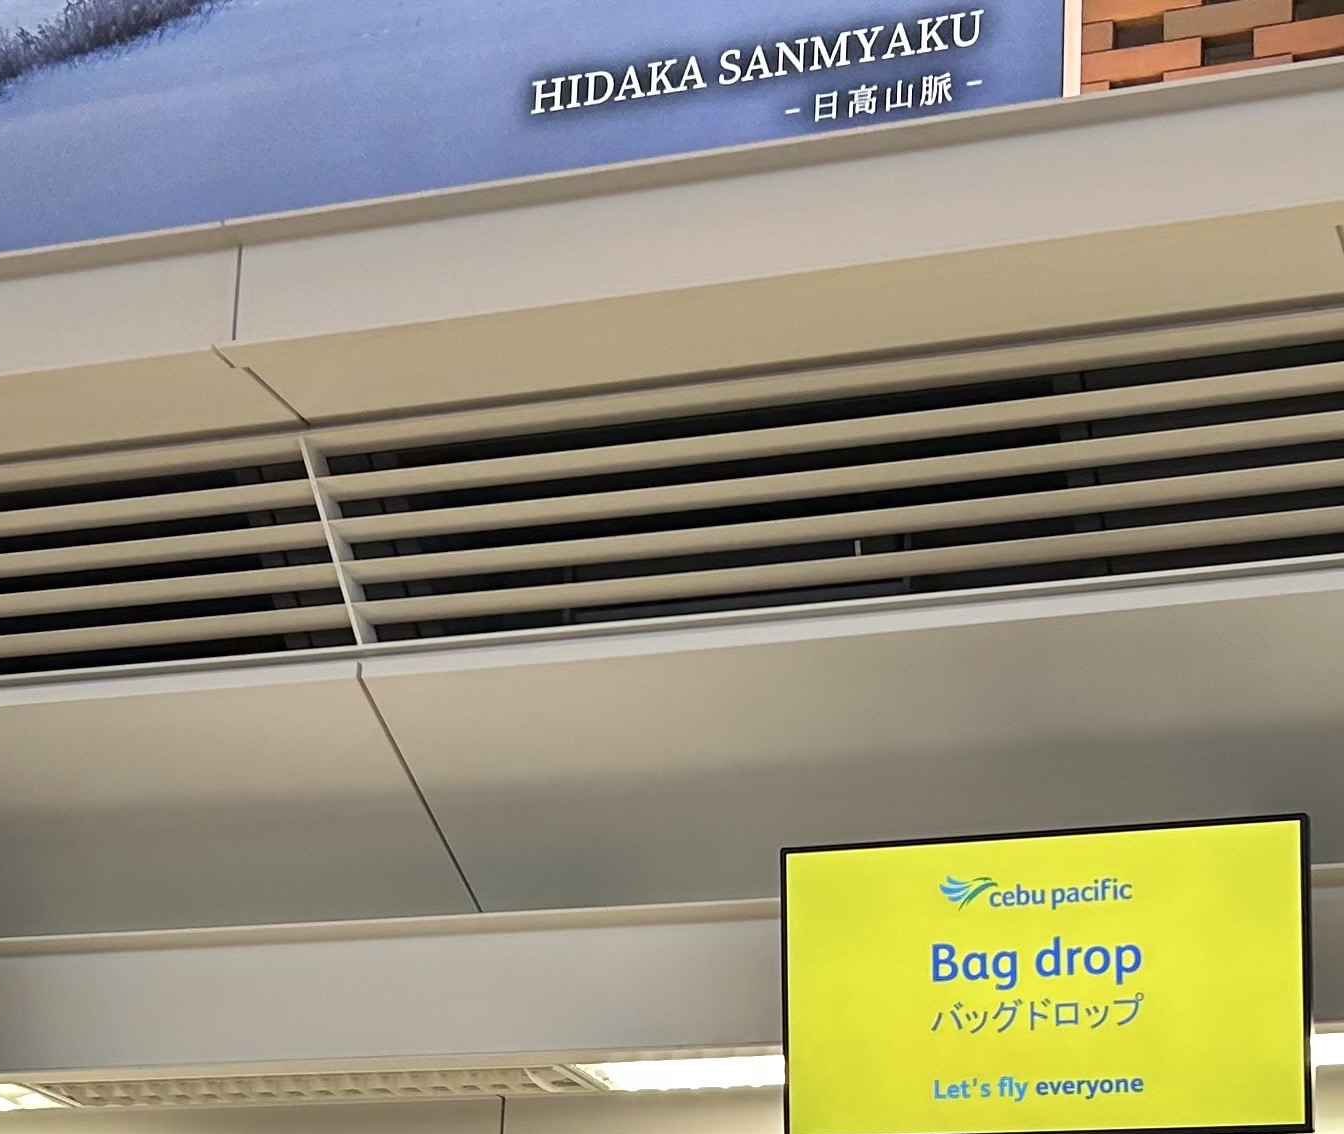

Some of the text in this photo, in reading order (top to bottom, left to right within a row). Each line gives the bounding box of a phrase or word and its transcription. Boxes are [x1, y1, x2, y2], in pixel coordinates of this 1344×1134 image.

[530, 10, 985, 114] HIDAKA SANMYAKU
[989, 877, 1133, 910] cebu pacific
[930, 936, 1143, 990] Bag drop
[930, 992, 1144, 1035] バッグドロップ
[934, 1075, 1144, 1102] Let's fly everyone
